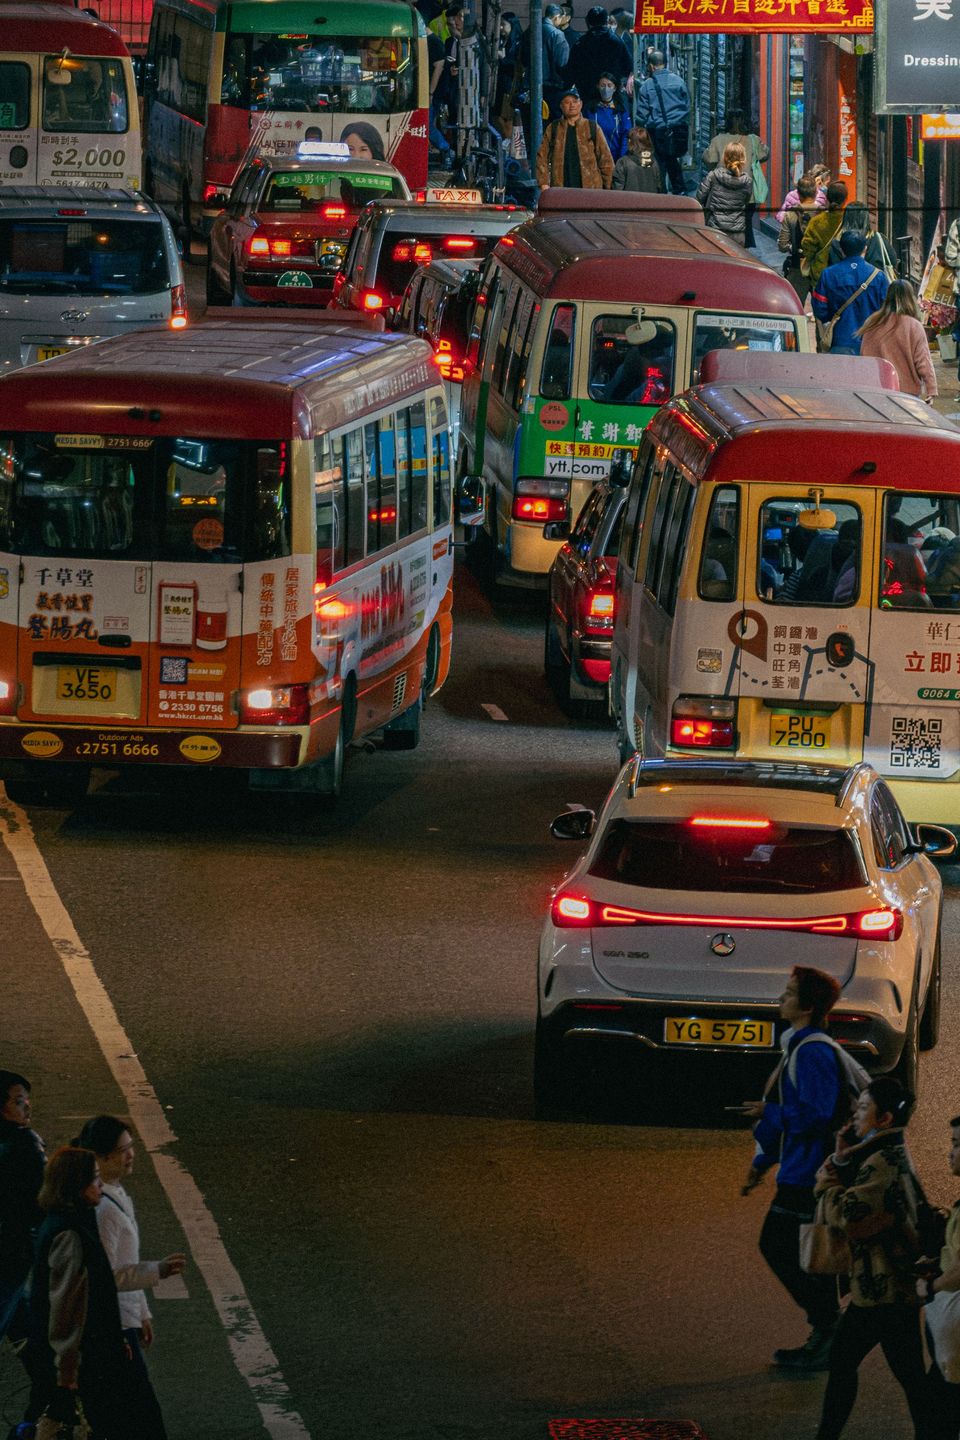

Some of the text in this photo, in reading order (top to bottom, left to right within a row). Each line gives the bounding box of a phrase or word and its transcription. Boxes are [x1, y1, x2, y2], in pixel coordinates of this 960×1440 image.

[903, 54, 960, 67] Dressin
[52, 147, 126, 169] $2,000
[433, 190, 477, 201] TAXI
[108, 437, 131, 447] 2751
[35, 567, 96, 588] 千草堂
[773, 625, 819, 640] 銅鑼灣
[772, 642, 802, 657] 中環
[772, 659, 801, 673] 旺角
[904, 650, 960, 675] 立即
[76, 668, 100, 685] VE
[771, 675, 801, 690] 荃灣
[62, 683, 112, 700] 3650
[922, 689, 951, 699] 9064
[171, 702, 225, 713] 2330 6756
[788, 716, 814, 731] PU
[98, 733, 128, 741] Outdoor
[774, 731, 826, 748] 7200
[83, 743, 160, 756] 2751 6666
[673, 1022, 765, 1042] YG 5751
